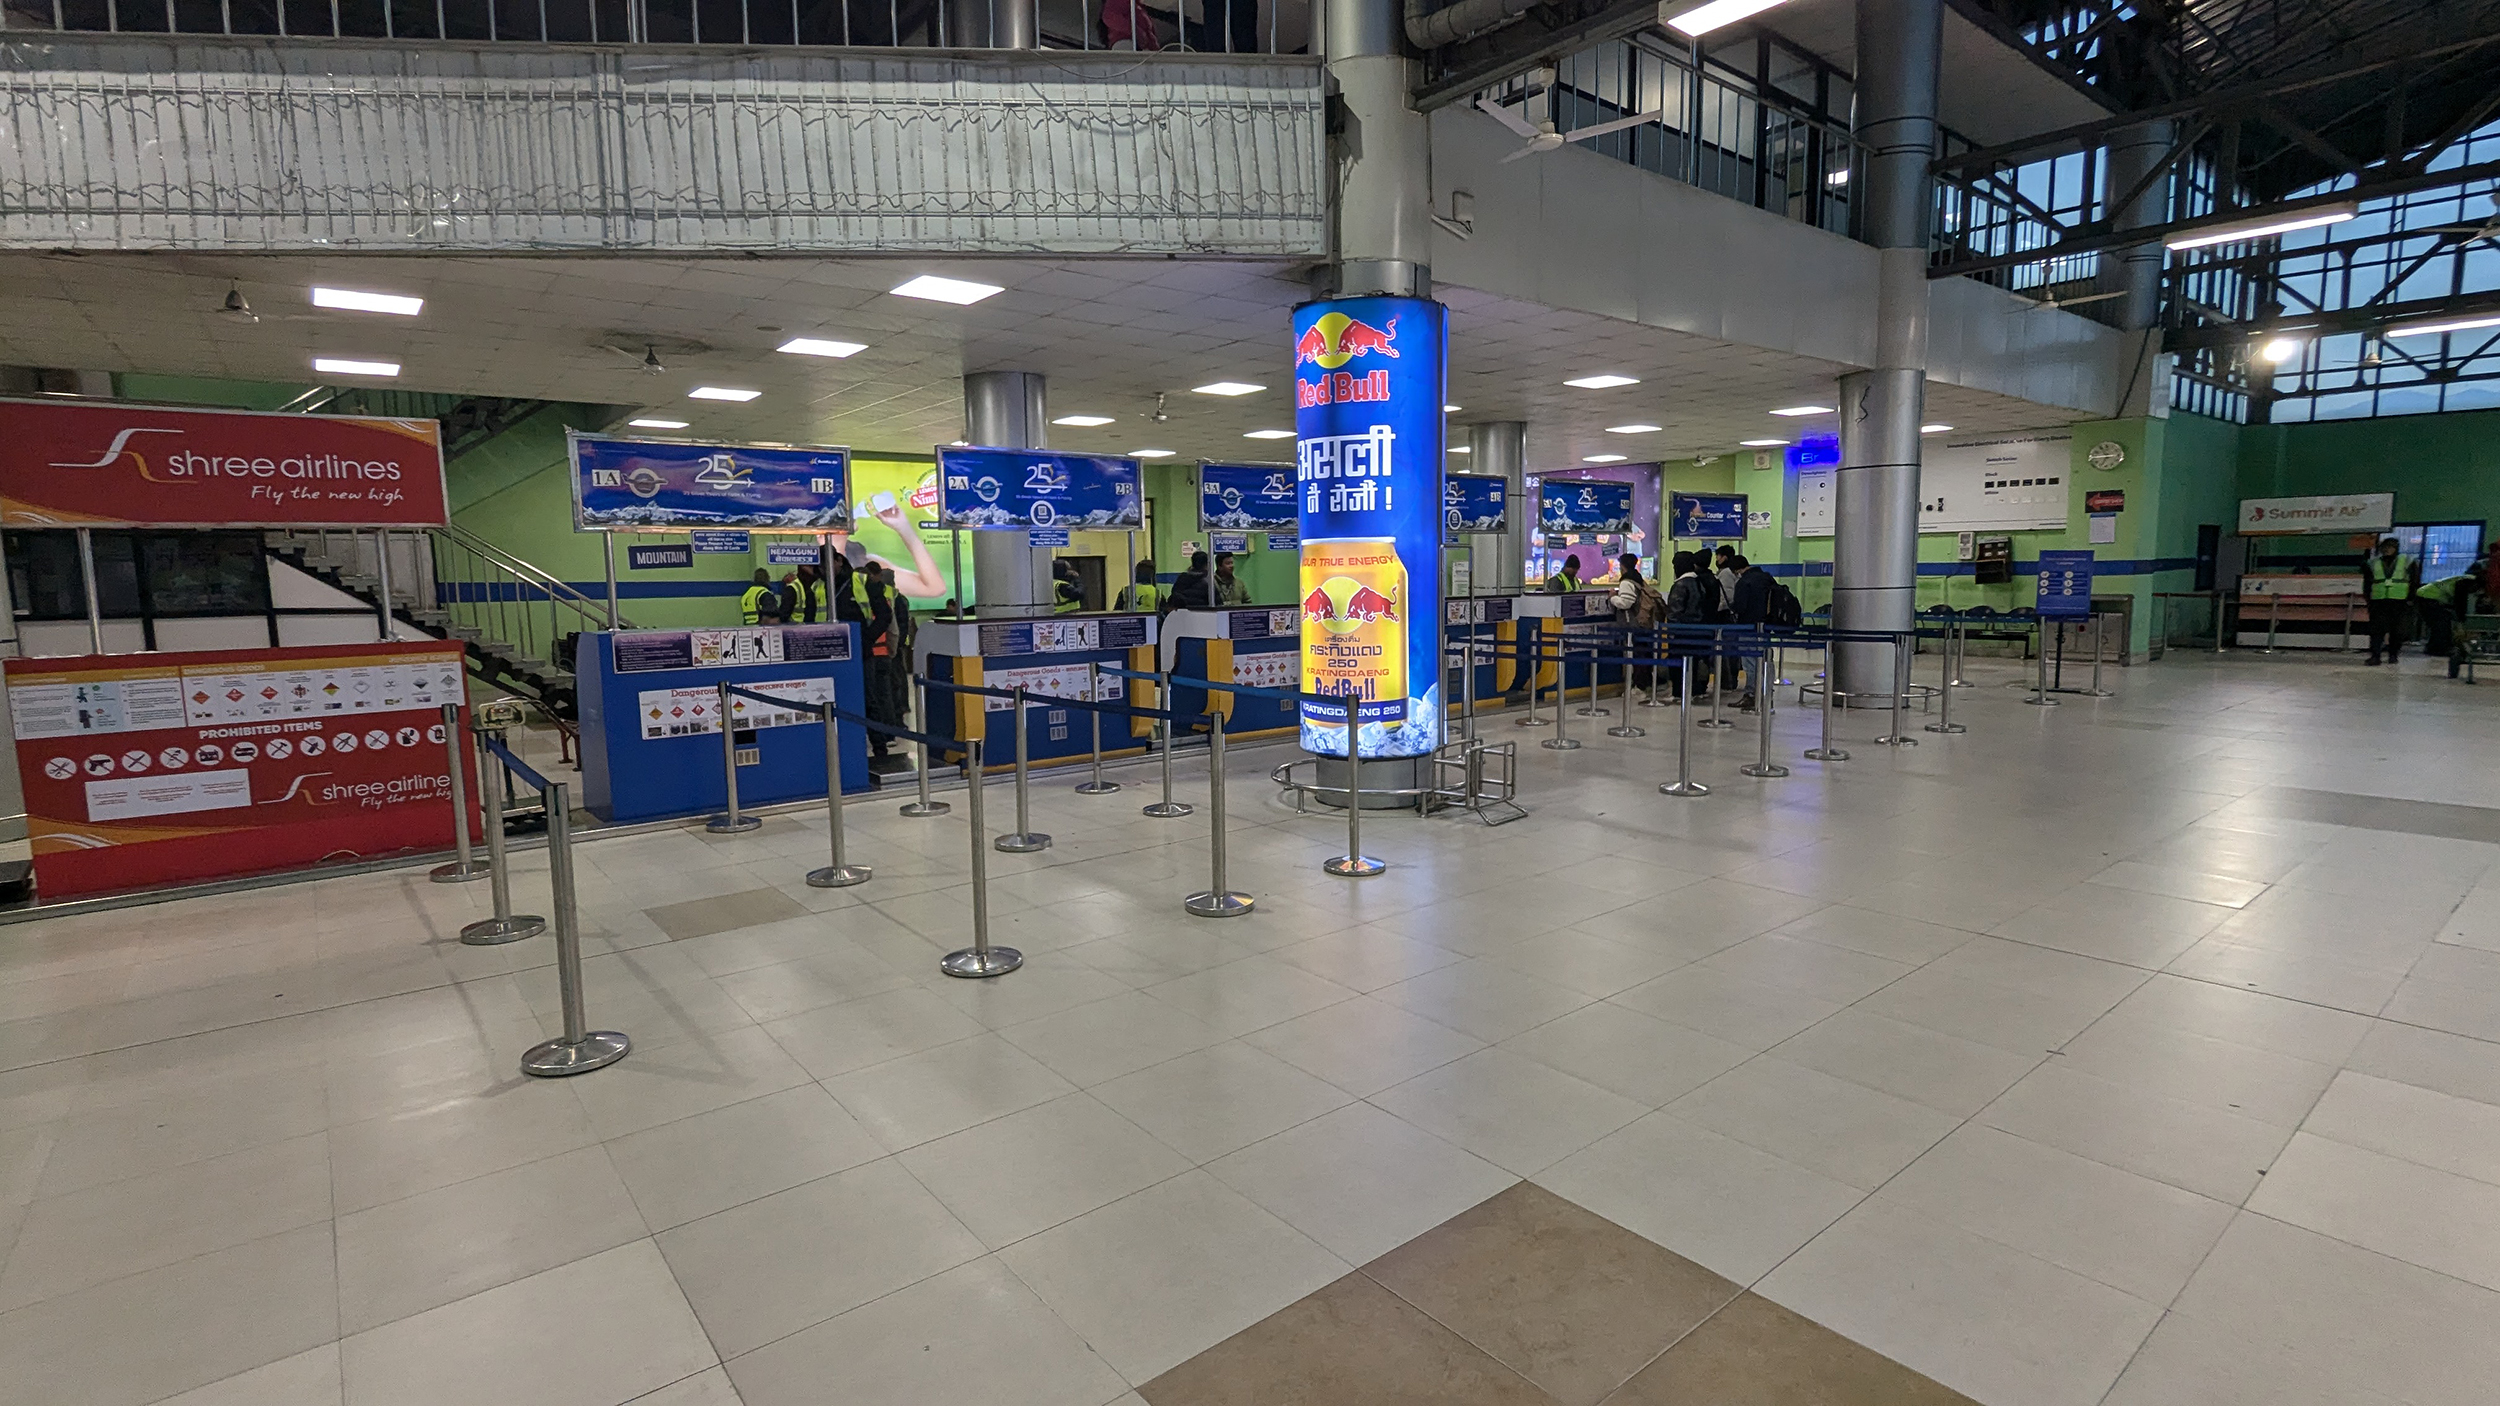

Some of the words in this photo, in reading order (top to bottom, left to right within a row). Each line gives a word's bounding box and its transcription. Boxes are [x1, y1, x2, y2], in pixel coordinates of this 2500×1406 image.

[1297, 374, 1332, 409] Red
[1333, 369, 1390, 403] Bull
[1298, 425, 1396, 481] असली
[168, 450, 275, 478] shree
[280, 454, 401, 480] airlines
[694, 454, 734, 490] 25
[594, 471, 619, 485] 1A
[950, 477, 968, 489] 2A
[1023, 463, 1052, 493] 25
[813, 480, 833, 492] 1B
[1116, 483, 1132, 494] 2B
[1205, 483, 1219, 493] 3A
[1261, 473, 1285, 500] 25
[251, 485, 284, 504] Fly
[291, 486, 320, 500] the
[328, 490, 362, 500] new
[368, 488, 404, 506] high
[1307, 482, 1321, 513] नै
[1385, 486, 1392, 511] !
[2269, 507, 2334, 520] Summit
[2339, 506, 2361, 516] Air
[636, 551, 687, 565] MOUNTAIN
[1302, 557, 1317, 567] OUR
[1319, 557, 1344, 566] TRUE
[1348, 555, 1394, 565] ENERGY
[1310, 643, 1382, 657] กระทิงแดง
[1328, 659, 1358, 668] 250
[1306, 667, 1390, 677] KRATINGDAENG
[671, 688, 719, 698] Dangerous
[1303, 703, 1380, 716] RATINGDENG
[1383, 705, 1401, 715] 250
[199, 725, 280, 739] PROHIBITED
[283, 721, 323, 733] ITEMS
[322, 783, 385, 800] shree
[387, 774, 451, 792] airline
[361, 797, 382, 810] Fly
[386, 793, 406, 803] the
[436, 787, 452, 800] hig
